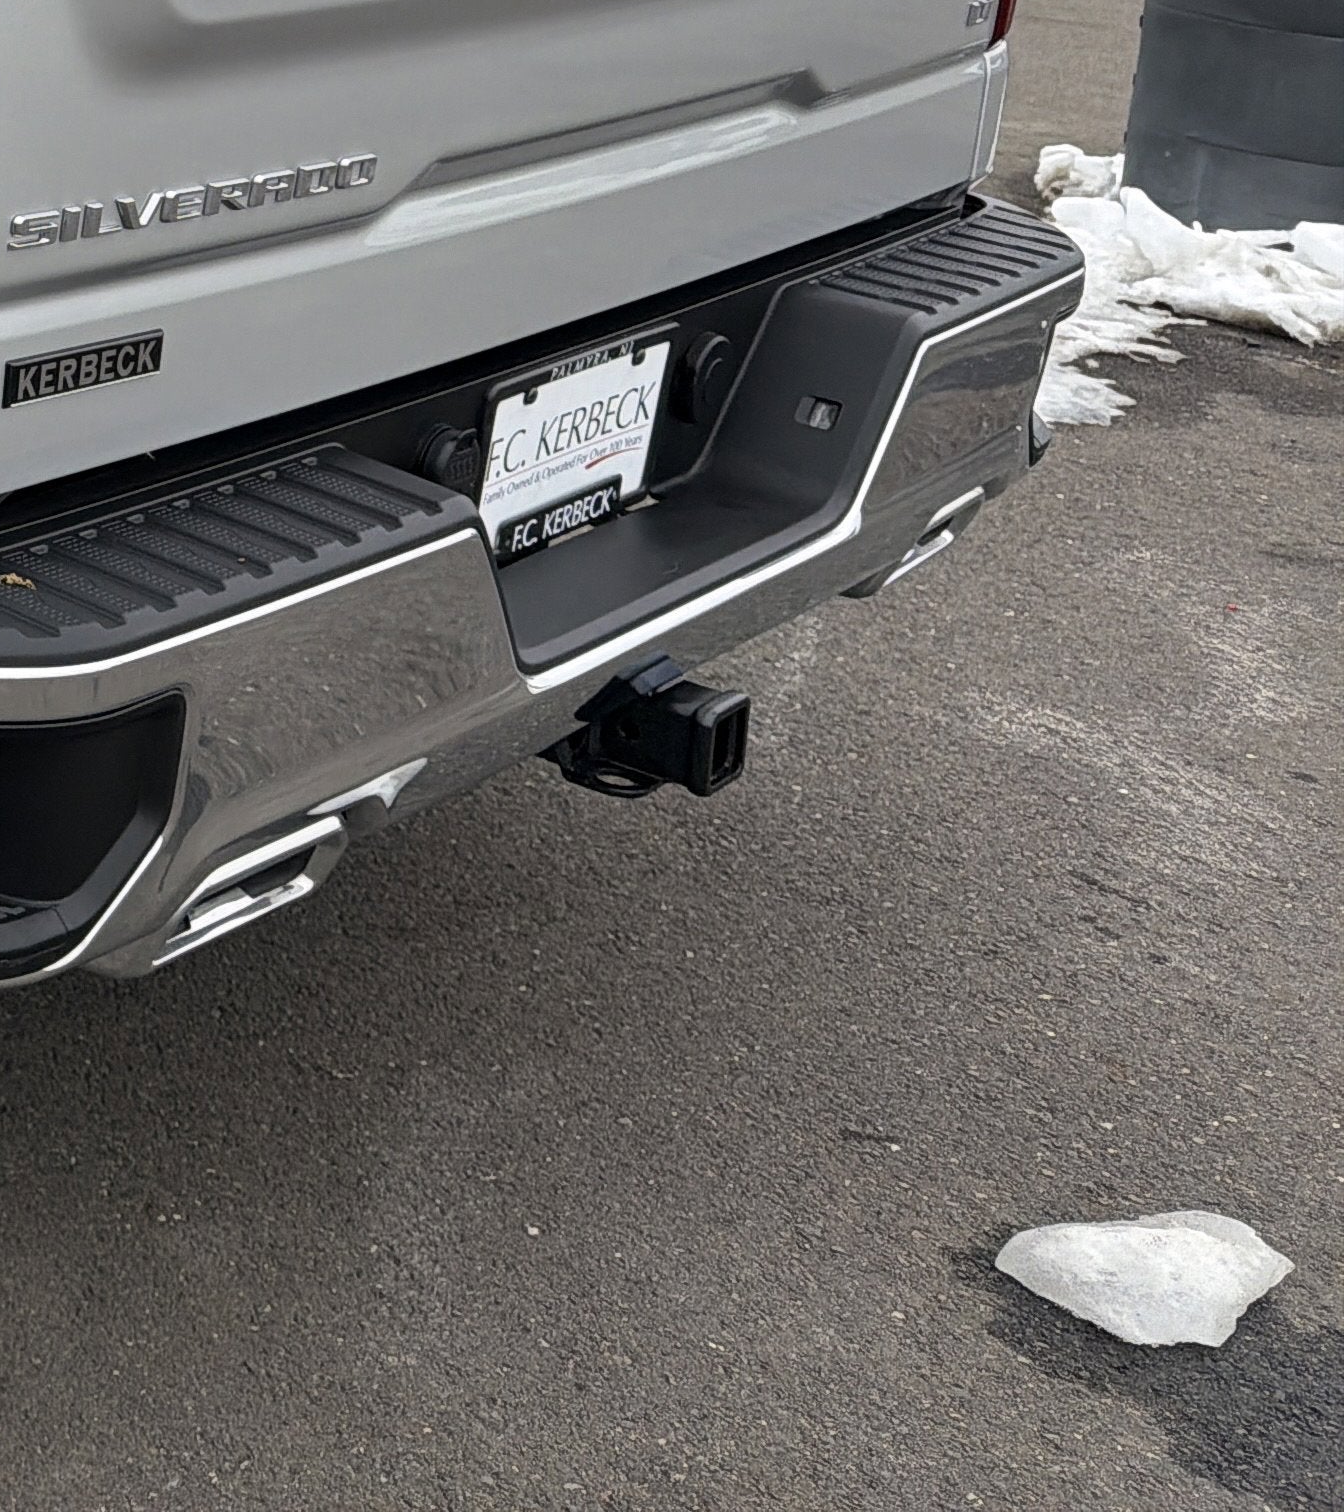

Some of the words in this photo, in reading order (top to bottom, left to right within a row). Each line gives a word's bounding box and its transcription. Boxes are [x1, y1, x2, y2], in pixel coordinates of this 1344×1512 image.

[7, 153, 378, 251] SILVERADO
[16, 338, 157, 401] KERBECK
[486, 429, 526, 483] F.C.
[535, 381, 656, 461] KERBECK
[589, 446, 608, 461] Over
[623, 435, 642, 449] Years
[511, 518, 538, 553] F.C.
[542, 486, 614, 540] KERBECK
